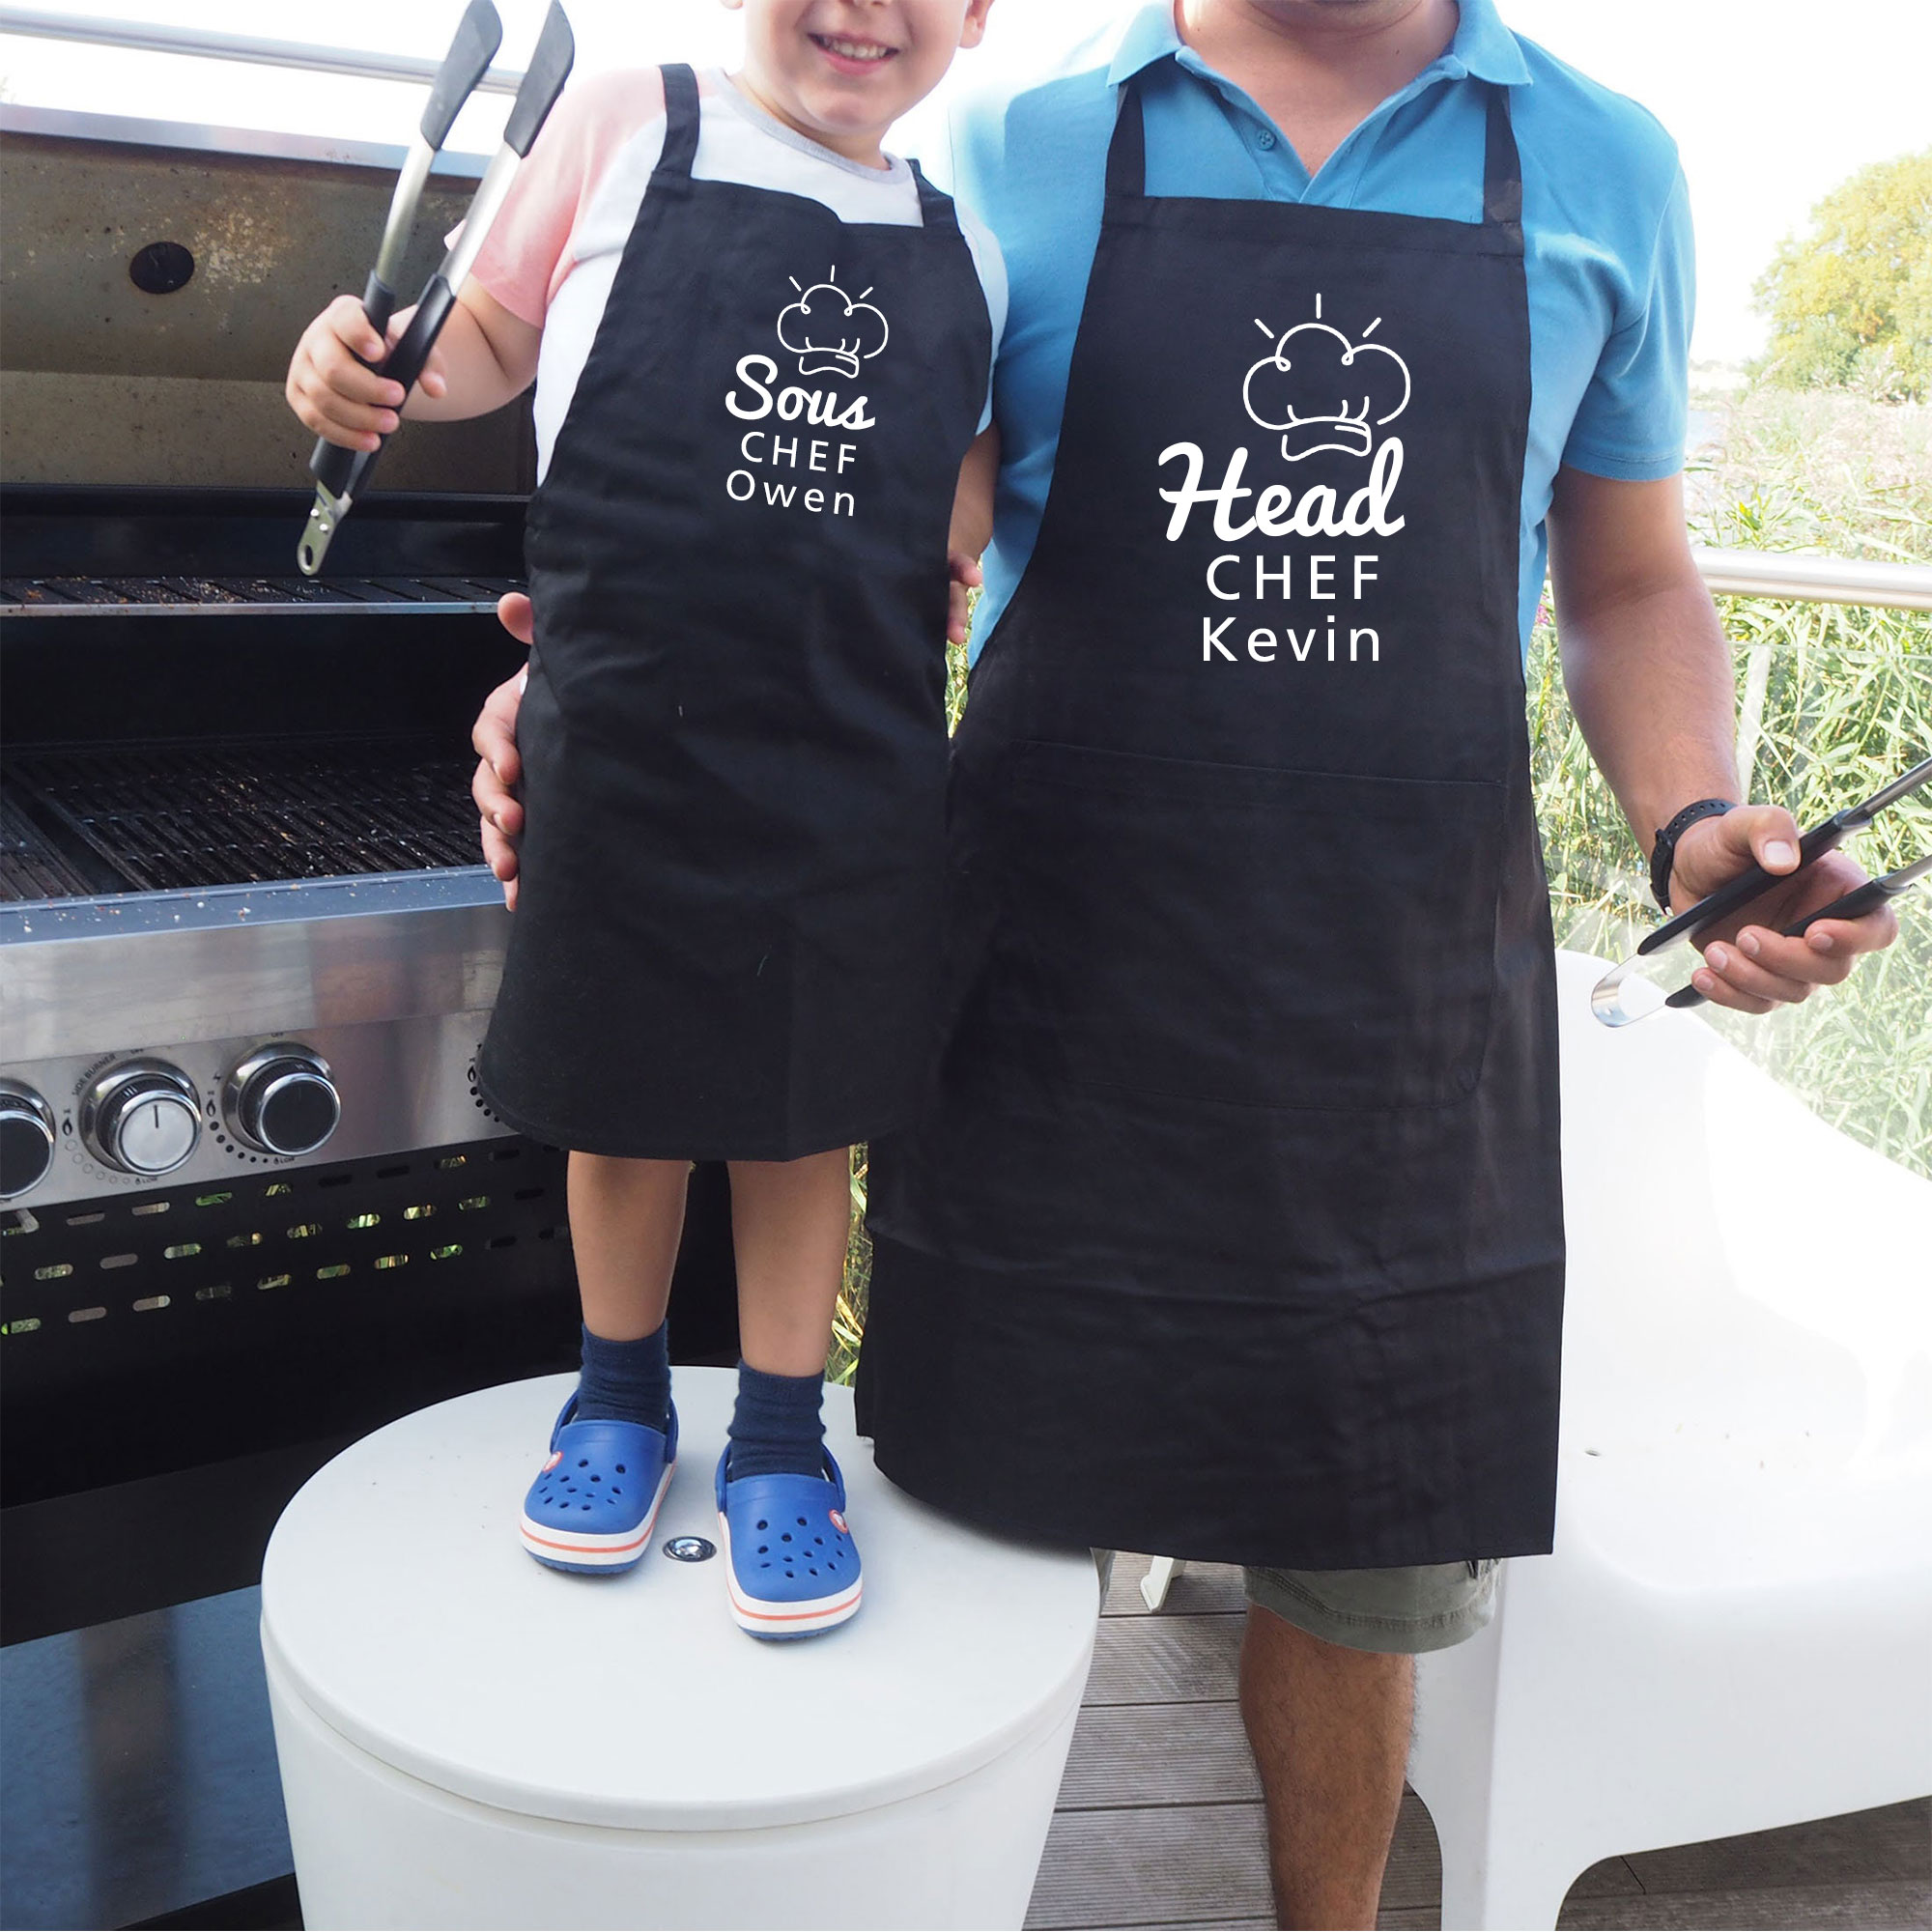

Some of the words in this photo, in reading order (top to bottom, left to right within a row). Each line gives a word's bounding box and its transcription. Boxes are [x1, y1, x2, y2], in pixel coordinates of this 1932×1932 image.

[725, 354, 876, 431] Sous
[740, 431, 857, 474] CHEF
[725, 469, 855, 517] Owen
[1157, 436, 1406, 542] Head
[1206, 554, 1379, 601] CHEF
[1202, 614, 1380, 663] Kevin
[84, 1053, 116, 1079] BURNER
